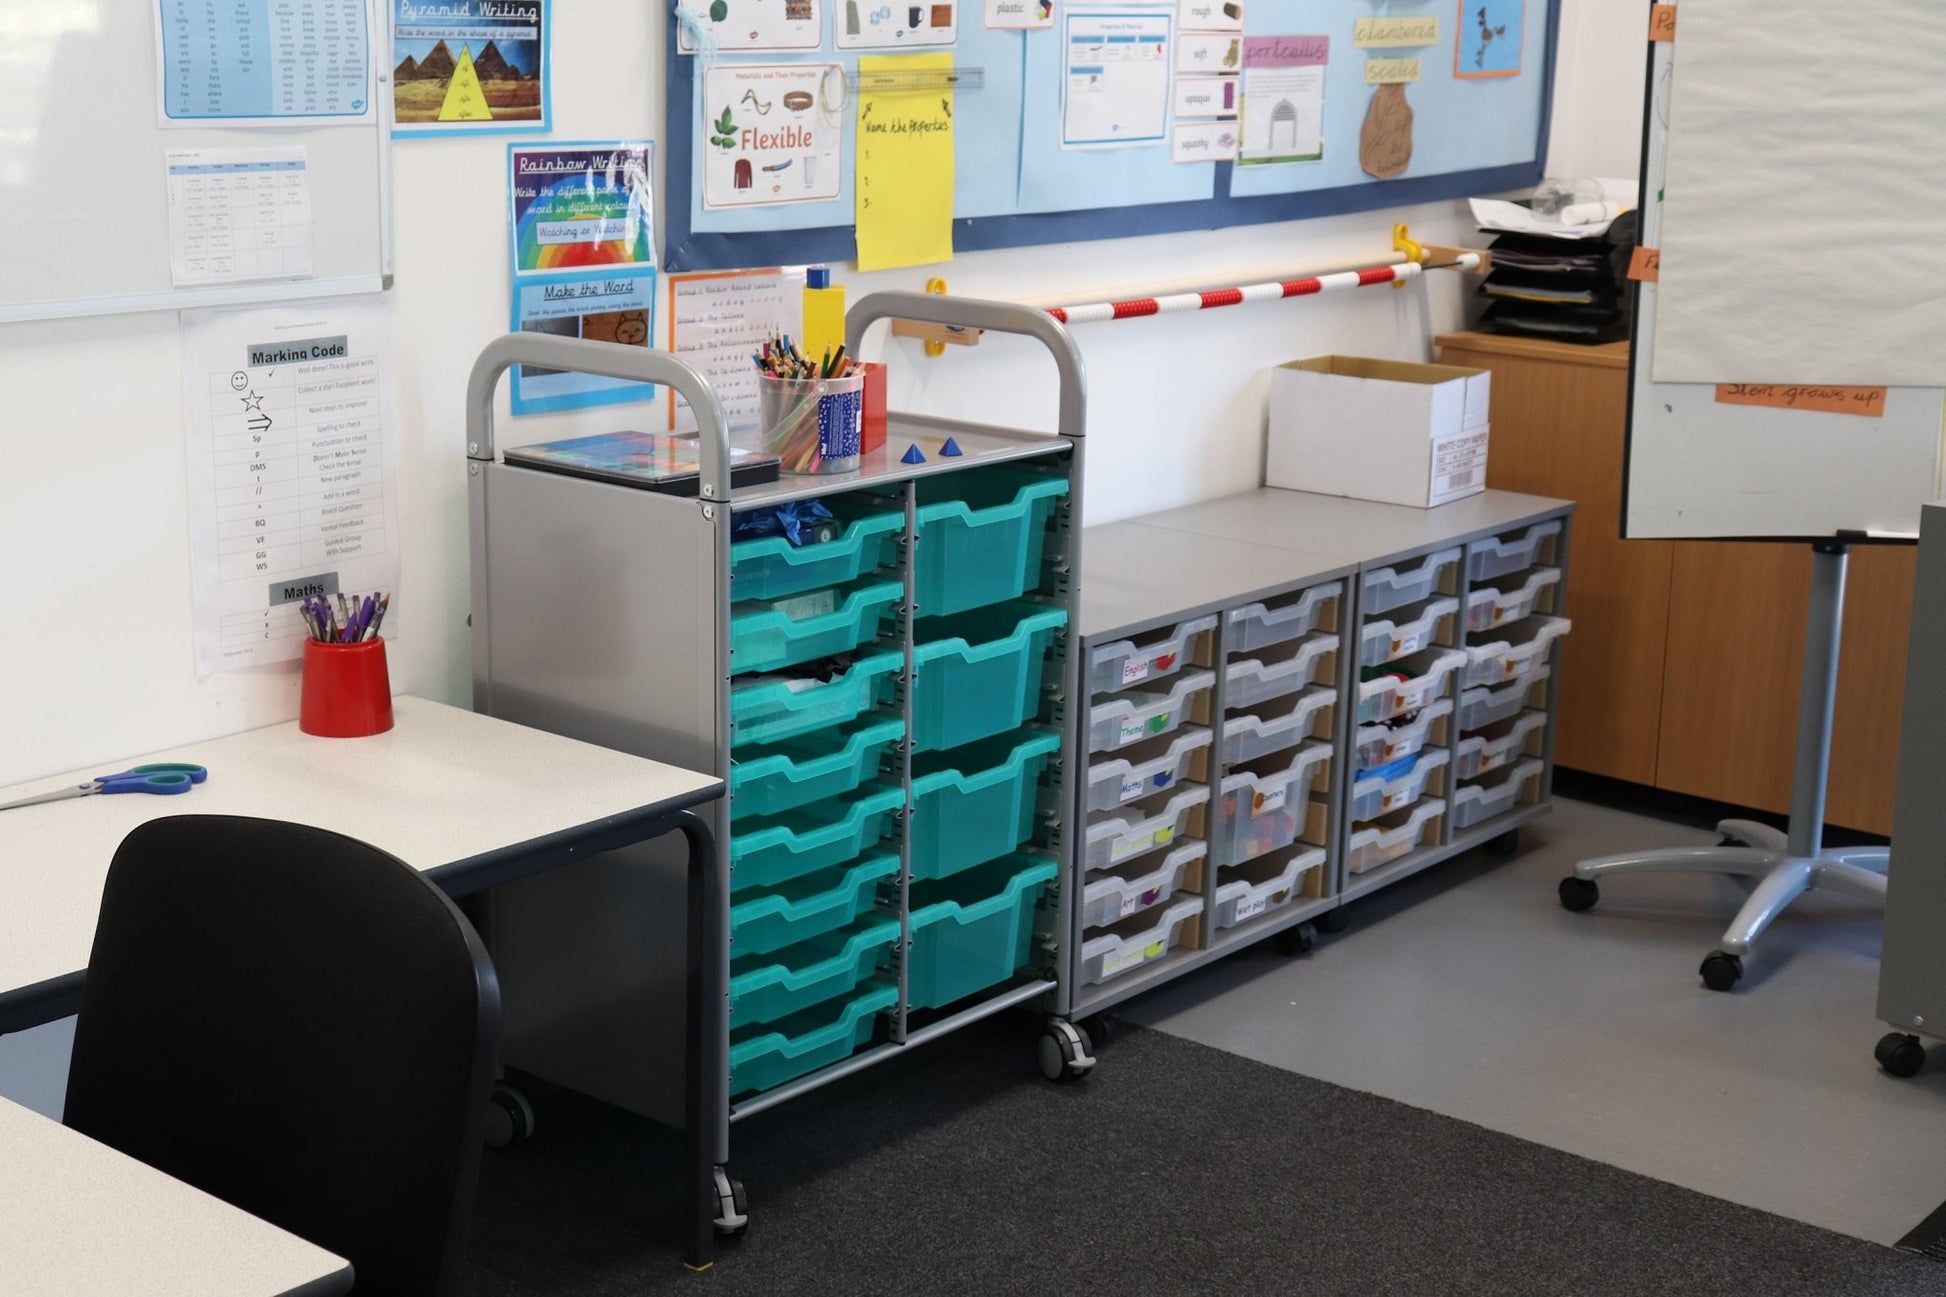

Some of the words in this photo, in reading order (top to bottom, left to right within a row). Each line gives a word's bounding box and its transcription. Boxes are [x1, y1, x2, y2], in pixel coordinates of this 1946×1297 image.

[400, 1, 470, 20] Pyramid
[480, 1, 537, 23] Writing
[997, 2, 1024, 15] plastic
[1192, 6, 1212, 18] rough
[1194, 48, 1208, 61] soft
[741, 124, 812, 150] Flexible
[520, 157, 586, 171] Rainbow
[539, 226, 577, 238] Watching
[543, 286, 575, 299] Make
[579, 283, 598, 296] the
[604, 280, 634, 293] Word
[252, 348, 307, 365] Marking
[312, 344, 344, 358] Code
[297, 366, 310, 374] Well
[329, 362, 340, 370] This
[346, 360, 359, 369] good
[298, 385, 317, 394] Collect
[1783, 387, 1845, 405] grows
[1853, 390, 1879, 407] up
[309, 406, 322, 414] Next
[317, 424, 337, 433] Spelling
[346, 420, 361, 428] check
[253, 435, 261, 443] Sp
[352, 434, 367, 442] check
[250, 463, 266, 471] DMS
[319, 462, 335, 471] Check
[255, 519, 265, 527] BQ
[256, 536, 265, 544] VF
[344, 535, 361, 543] Group
[340, 544, 361, 553] Support
[256, 551, 266, 559] GG
[256, 562, 268, 570] WS
[284, 583, 324, 600] Maths
[1124, 661, 1148, 677] English
[1121, 724, 1144, 737] Theme
[1122, 780, 1142, 793] Maths
[1238, 904, 1251, 916] Wet
